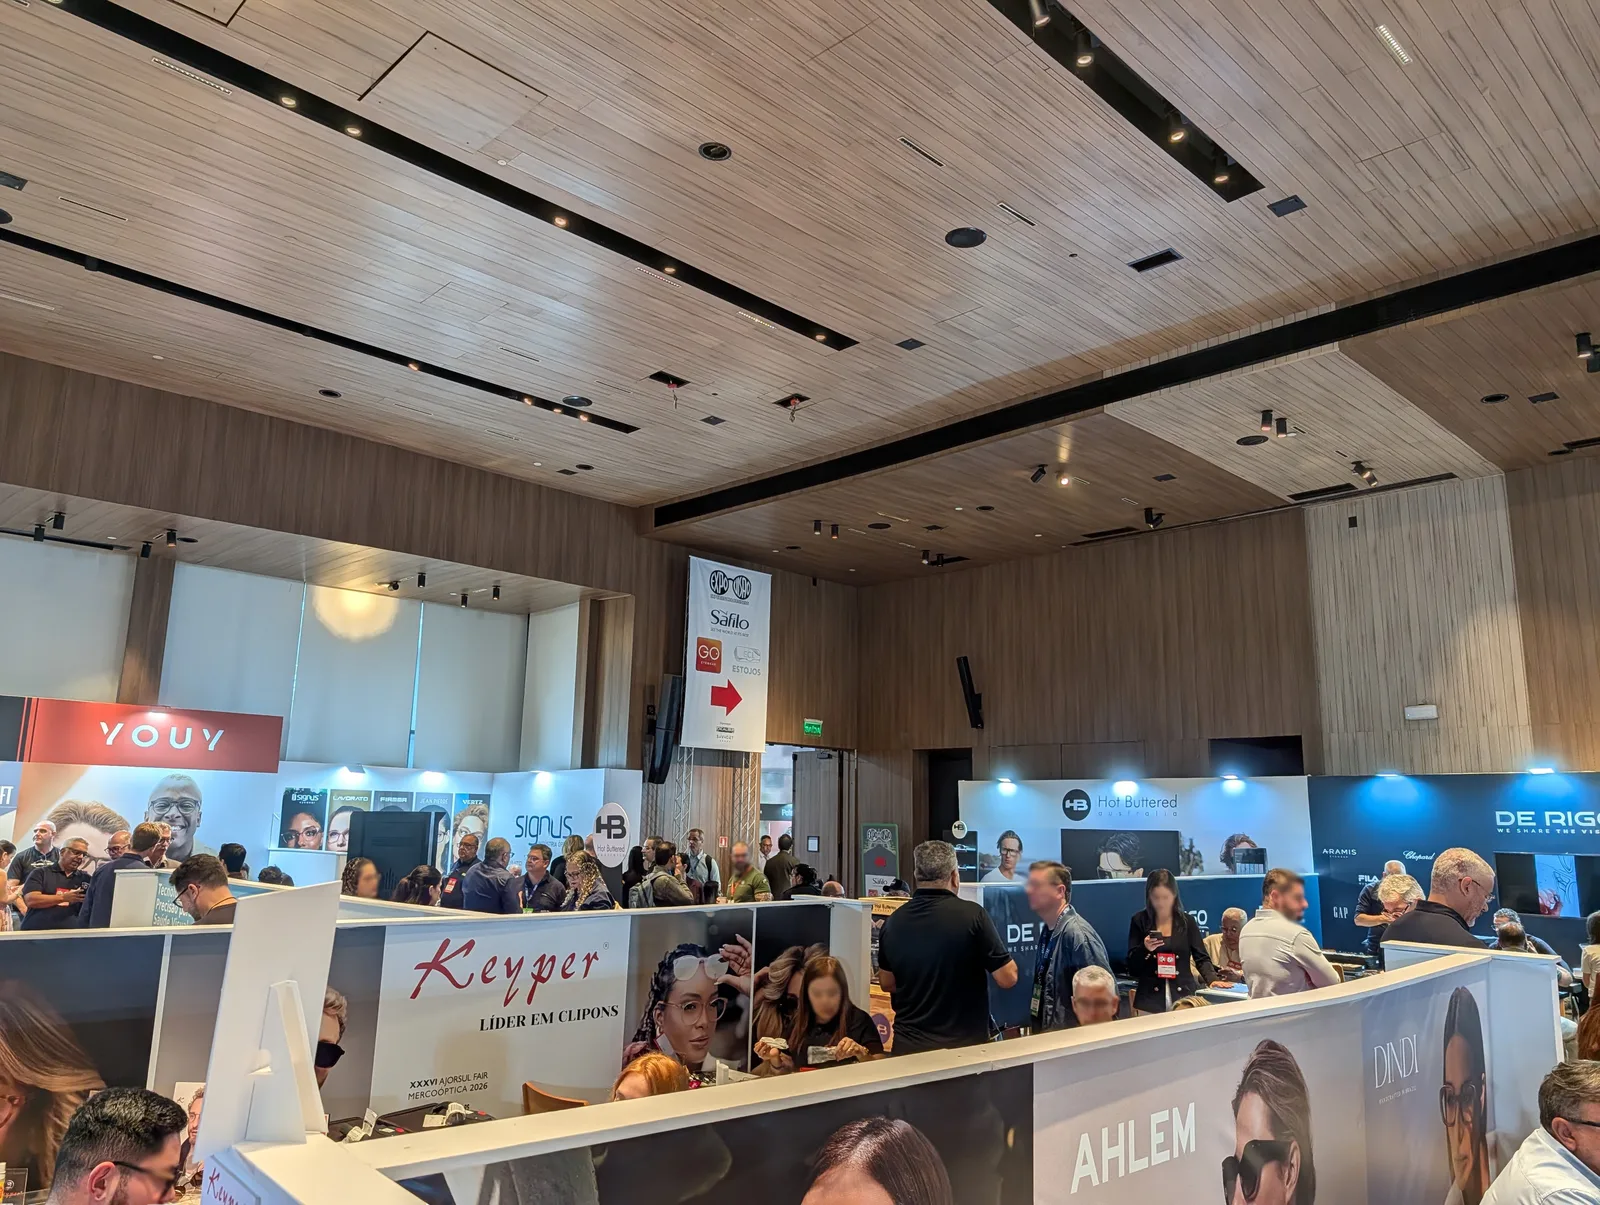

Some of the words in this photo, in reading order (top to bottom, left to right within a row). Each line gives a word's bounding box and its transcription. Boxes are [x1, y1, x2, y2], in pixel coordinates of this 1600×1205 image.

[698, 645, 720, 660] GO
[732, 665, 761, 676] ESTOJOS
[100, 721, 224, 751] YOUY
[1065, 800, 1088, 811] HB
[1098, 795, 1120, 808] Hot
[1126, 794, 1178, 808] Buttered
[596, 815, 626, 839] HB
[1495, 811, 1536, 826] DE
[1544, 811, 1600, 826] RIG
[1403, 850, 1436, 861] Chopard
[1333, 906, 1348, 918] GAP
[1007, 923, 1034, 942] DE
[410, 938, 599, 1008] Keyper
[480, 1015, 526, 1032] LÍDER
[530, 1012, 554, 1026] EM
[558, 1005, 619, 1022] CLIPONS
[1374, 1034, 1419, 1088] DINDI
[410, 1078, 438, 1088] XXXVI
[438, 1074, 472, 1086] AJORSUL
[473, 1072, 488, 1080] FAIR
[408, 1085, 468, 1100] MERCOÓPTICA
[469, 1082, 488, 1092] 2026
[1070, 1102, 1196, 1194] AHLEM
